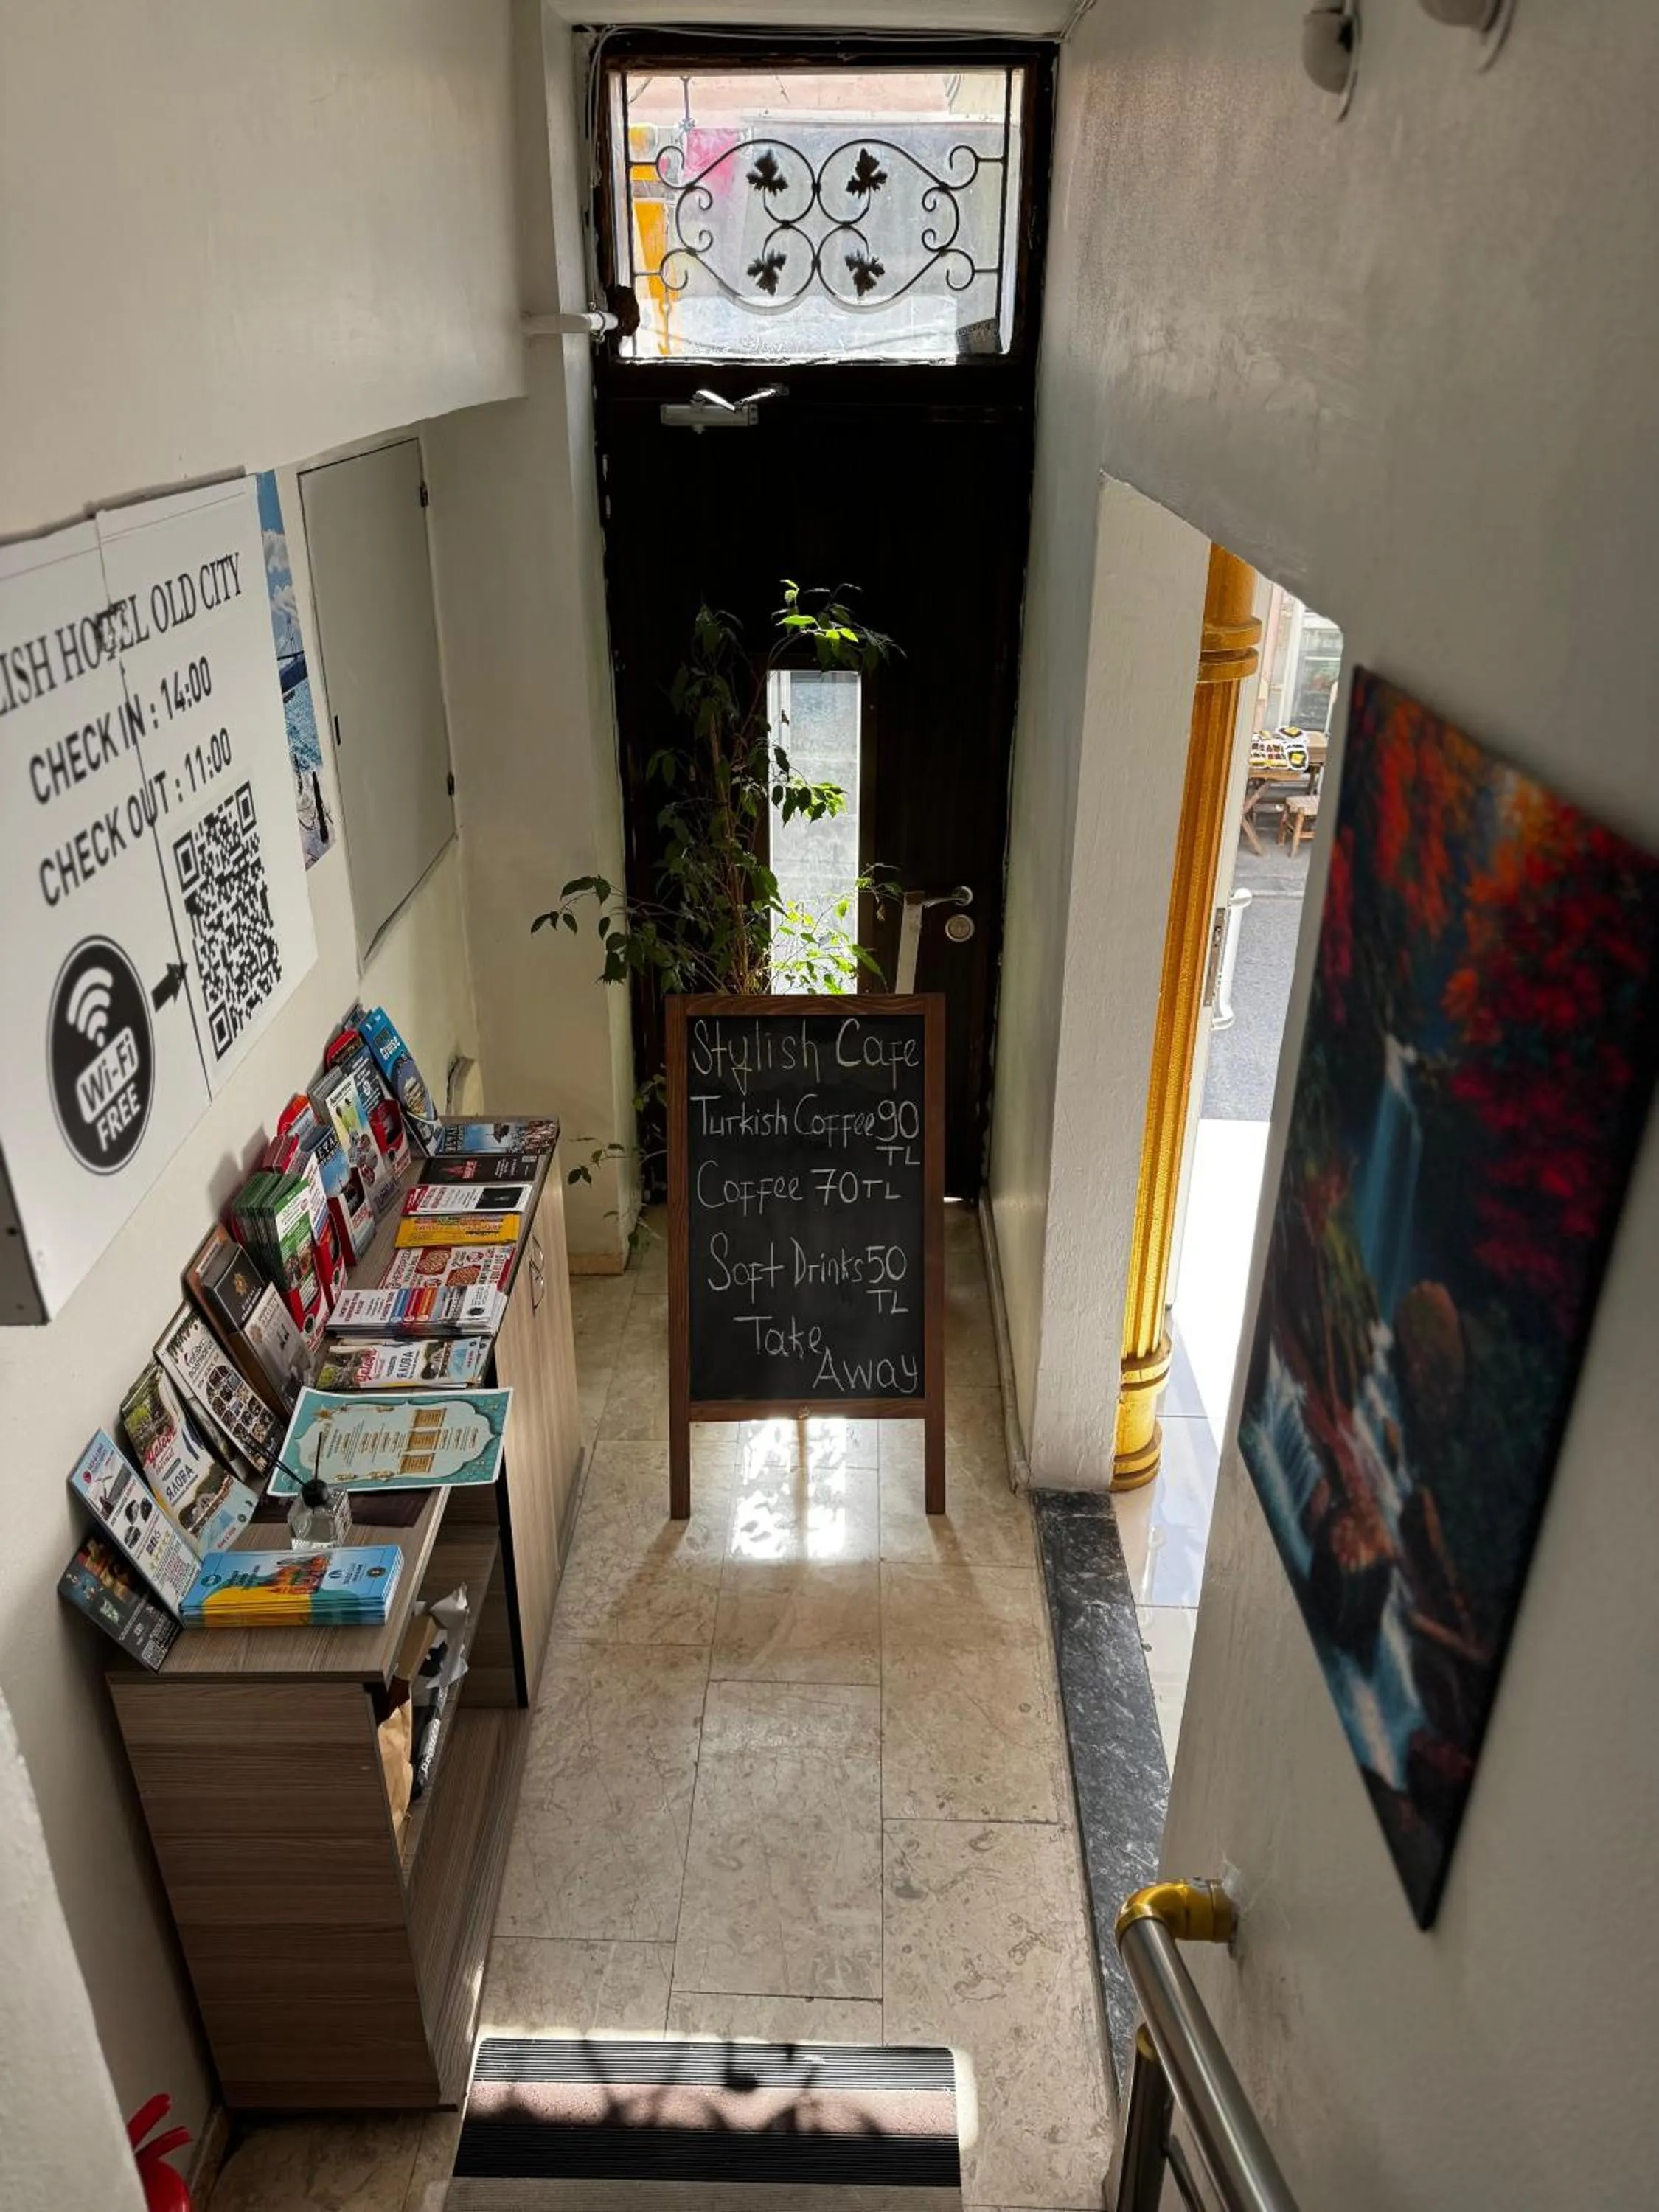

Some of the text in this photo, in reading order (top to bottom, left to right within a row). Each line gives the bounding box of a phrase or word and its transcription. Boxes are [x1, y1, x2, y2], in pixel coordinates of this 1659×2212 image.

[151, 575, 196, 633] OLD
[200, 552, 243, 610] CITY
[29, 712, 121, 805] CHECK
[118, 693, 146, 750] IN
[159, 656, 212, 720] 14:00
[38, 806, 128, 908] CHECK
[128, 770, 173, 841] OUT
[184, 727, 232, 793] 11:00
[80, 1033, 136, 1113] Wi-Fi
[692, 1018, 921, 1096] Stylish Cafe
[97, 1082, 141, 1152] FREE
[690, 1093, 920, 1148] Turkish Coffee 90
[696, 1159, 804, 1217] Coffee
[875, 1146, 921, 1166] TL
[706, 1231, 908, 1303] Soft Drinks 50
[866, 1289, 910, 1315] TL
[733, 1315, 824, 1360] Take
